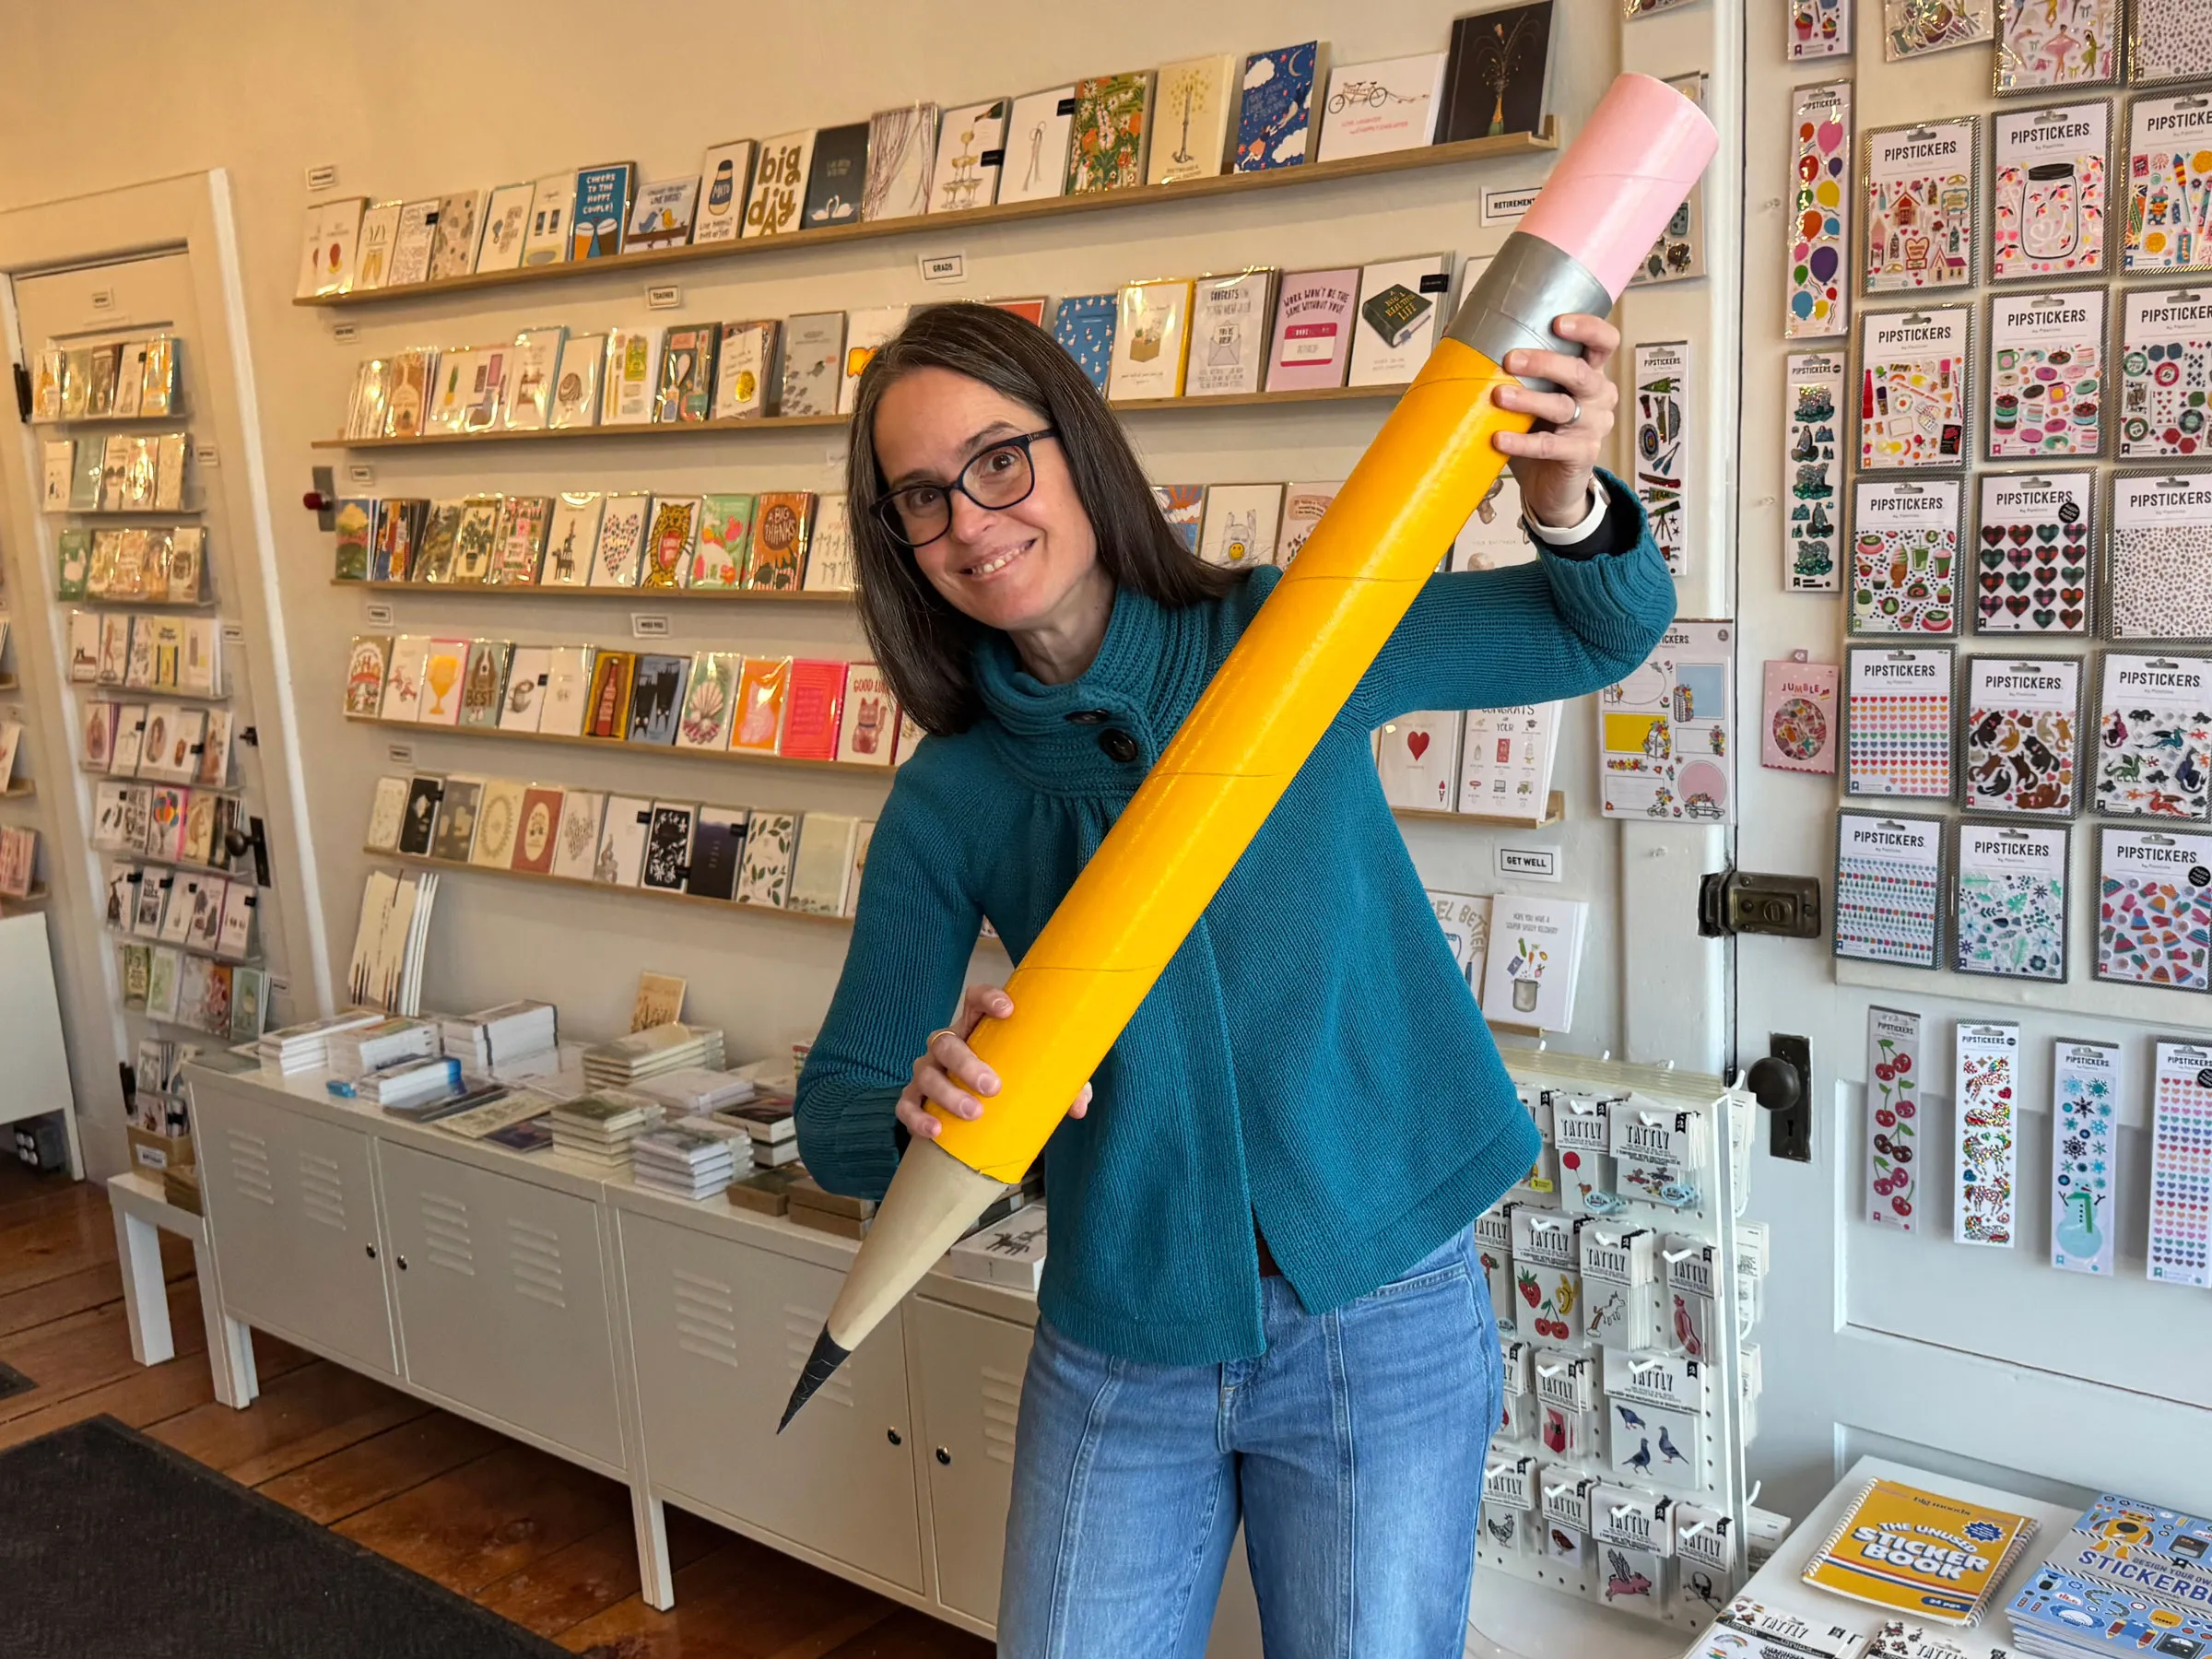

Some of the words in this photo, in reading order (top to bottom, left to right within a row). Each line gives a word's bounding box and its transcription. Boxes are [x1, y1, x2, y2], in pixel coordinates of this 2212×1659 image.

[2010, 123, 2091, 144] PIPSTICKERS
[1884, 140, 1958, 162] PIPSTICKERS
[757, 145, 802, 187] big
[932, 263, 953, 274] GRADS
[1283, 291, 1302, 308] WORK
[1304, 286, 1326, 300] WON'T
[1327, 288, 1336, 298] BE
[1336, 290, 1350, 303] THE
[1285, 302, 1300, 319] SAME
[1301, 300, 1328, 312] WITHOUT
[2007, 309, 2087, 326] PIPSTICKERS
[1877, 325, 1952, 343] PIPSTICKERS
[1870, 497, 1944, 512] PIPSTICKERS
[1995, 490, 2073, 506] PIPSTICKERS
[2130, 489, 2212, 508] PIPSTICKERS
[1662, 634, 1689, 645] ICKERS
[1864, 664, 1936, 677] PIPSTICKERS
[2119, 671, 2202, 688] PIPSTICKERS
[853, 678, 874, 693] GOOD
[1781, 682, 1820, 694] JUMBLE
[1985, 675, 2064, 690] PIPSTICKERS
[465, 688, 496, 708] BEST
[1497, 723, 1514, 733] YOUR
[1853, 830, 1925, 848] PIPSTICKERS
[1974, 841, 2051, 858] PIPSTICKERS
[2117, 845, 2198, 865] PIPSTICKERS
[1507, 855, 1522, 865] GET
[1524, 858, 1547, 868] WELL
[1433, 900, 1454, 922] EL
[1877, 1021, 1915, 1035] PIPSTICKERS
[1961, 1035, 2006, 1045] PIPSTICKERS
[2065, 1055, 2111, 1067] PIPSTICKERS
[1560, 1118, 1602, 1140] TATTLY
[1625, 1124, 1670, 1150] TATTLY
[1527, 1228, 1570, 1252] TATTLY
[1585, 1246, 1626, 1273] TATTLY
[1673, 1260, 1708, 1285] TATTLY
[1542, 1376, 1573, 1400] TATTLY
[1632, 1369, 1674, 1393] TATTLY
[1487, 1475, 1523, 1496] TATTLY
[1609, 1511, 1650, 1536] TATTLY
[1877, 1522, 1912, 1532] THE
[1914, 1524, 1979, 1553] UNUSED
[1852, 1526, 1990, 1572] STICKER
[1861, 1543, 1966, 1581] BOOK
[2132, 1558, 2168, 1572] DESIGN
[2170, 1568, 2194, 1581] YOUR
[2195, 1576, 2212, 1587] OW
[1761, 1614, 1811, 1640] TATTLY
